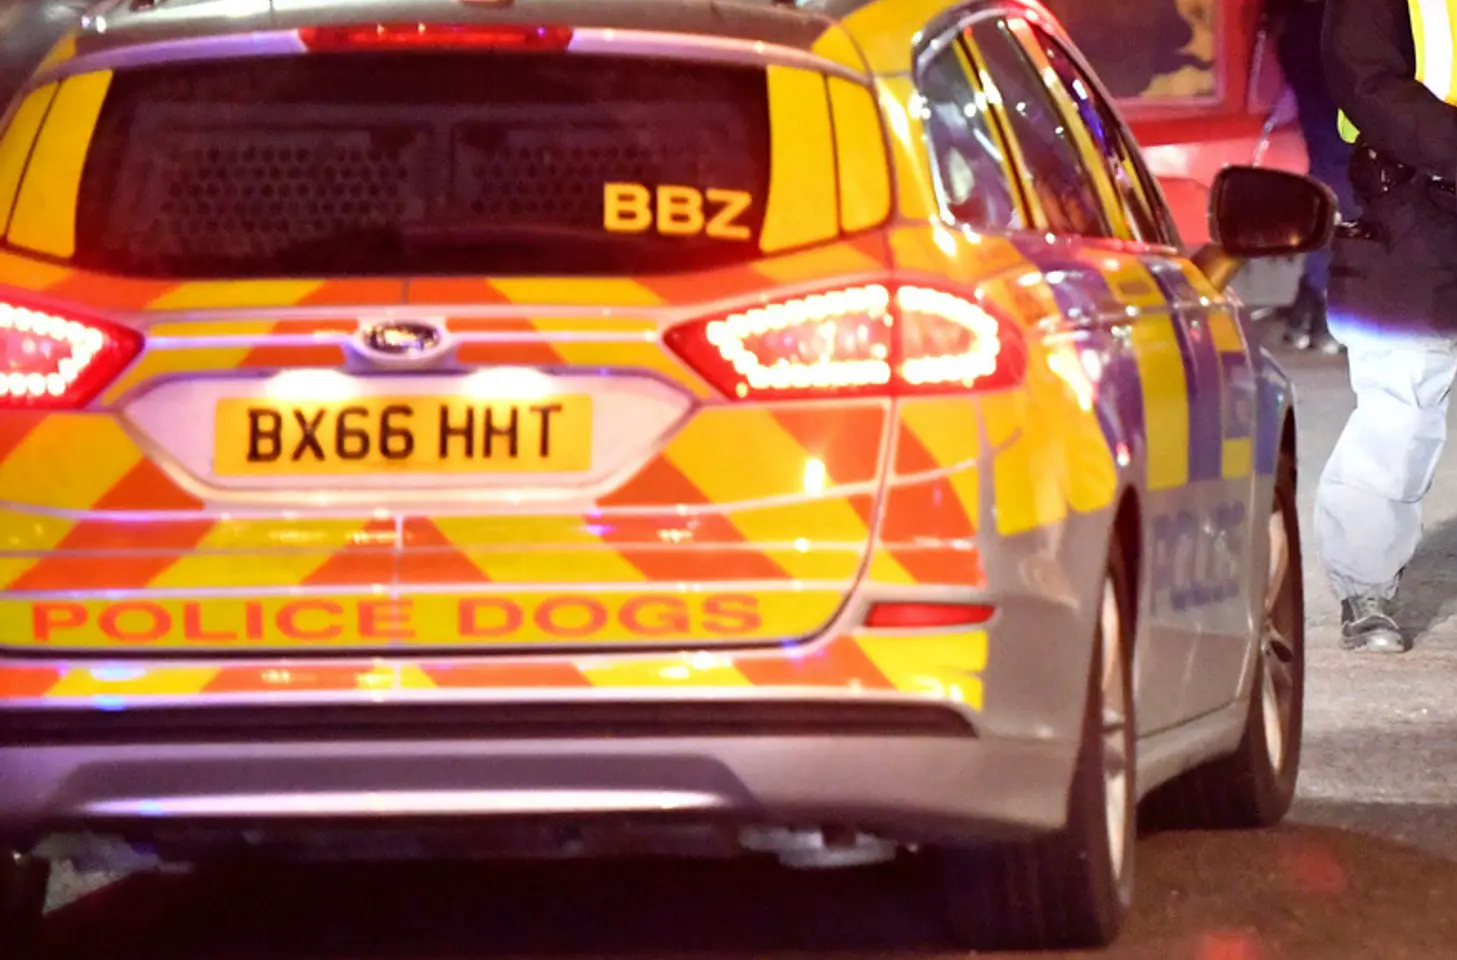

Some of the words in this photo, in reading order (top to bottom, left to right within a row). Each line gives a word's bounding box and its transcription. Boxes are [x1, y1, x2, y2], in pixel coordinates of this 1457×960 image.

[603, 183, 752, 239] BBZ
[246, 405, 416, 462] BX66
[438, 404, 563, 460] HHT
[30, 598, 415, 642] POLICE
[457, 594, 763, 635] DOGS
